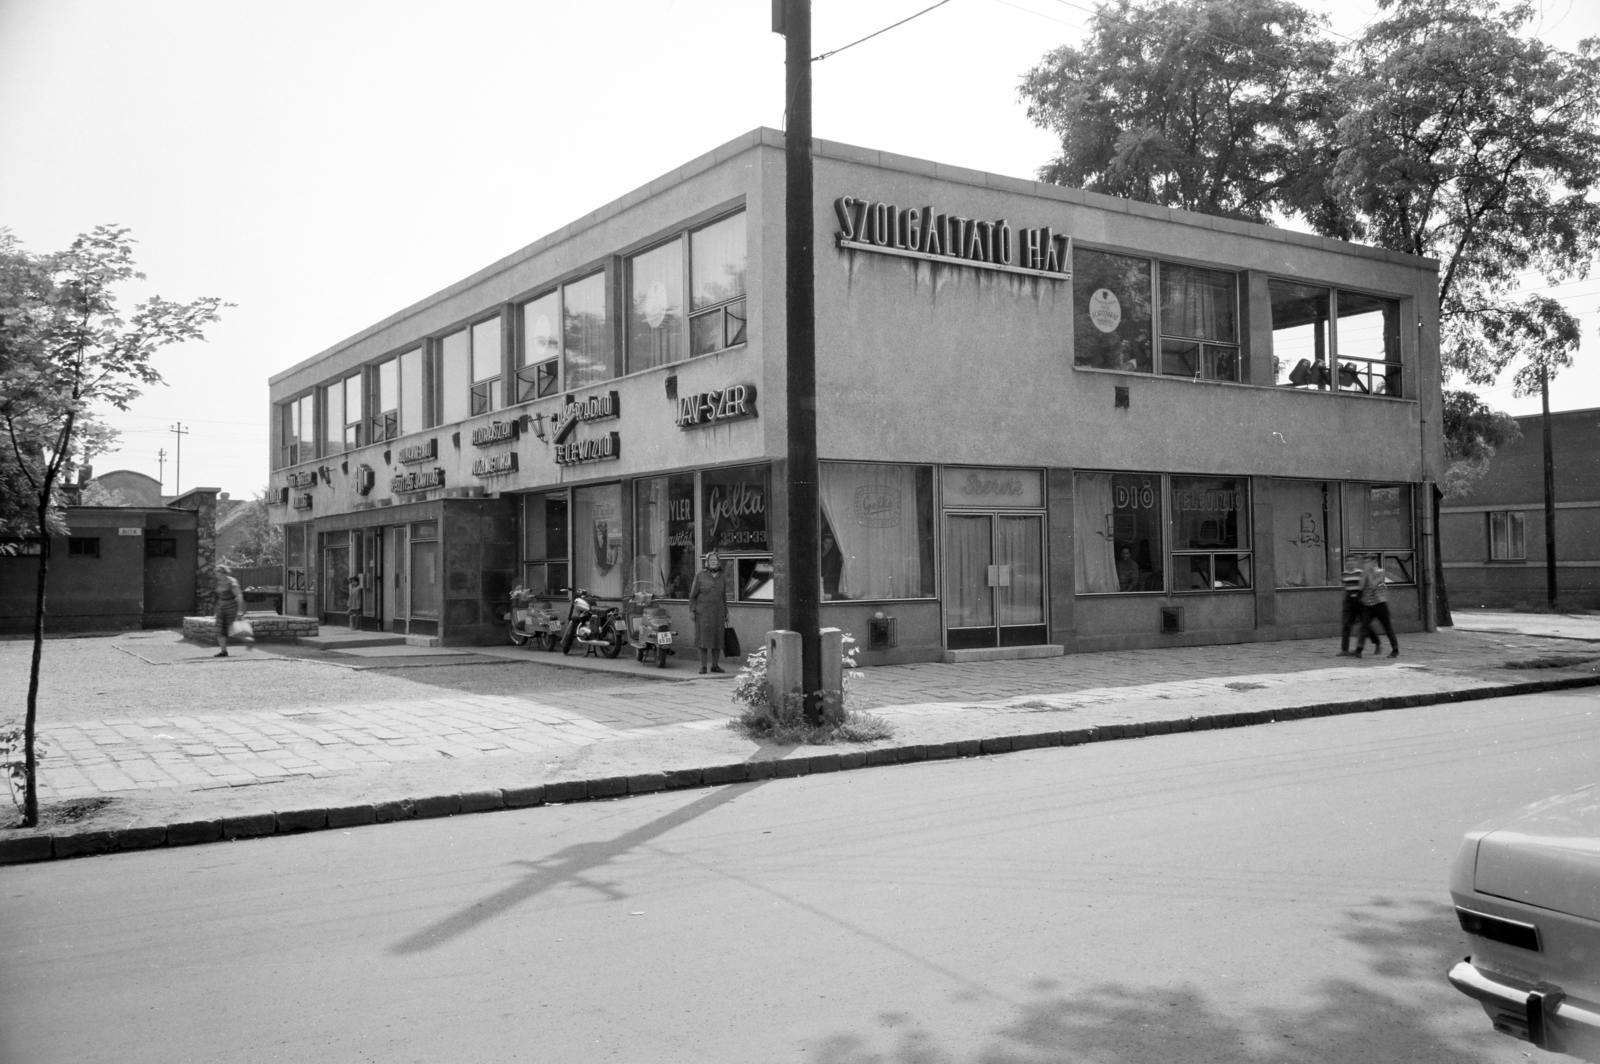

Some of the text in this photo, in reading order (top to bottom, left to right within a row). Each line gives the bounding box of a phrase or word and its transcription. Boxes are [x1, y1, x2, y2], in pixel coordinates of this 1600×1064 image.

[836, 195, 1072, 273] SZOLGÁLTATÓ HÁZ
[710, 481, 764, 537] Gelka
[863, 495, 894, 516] Gelka
[1115, 479, 1155, 509] DIÓ
